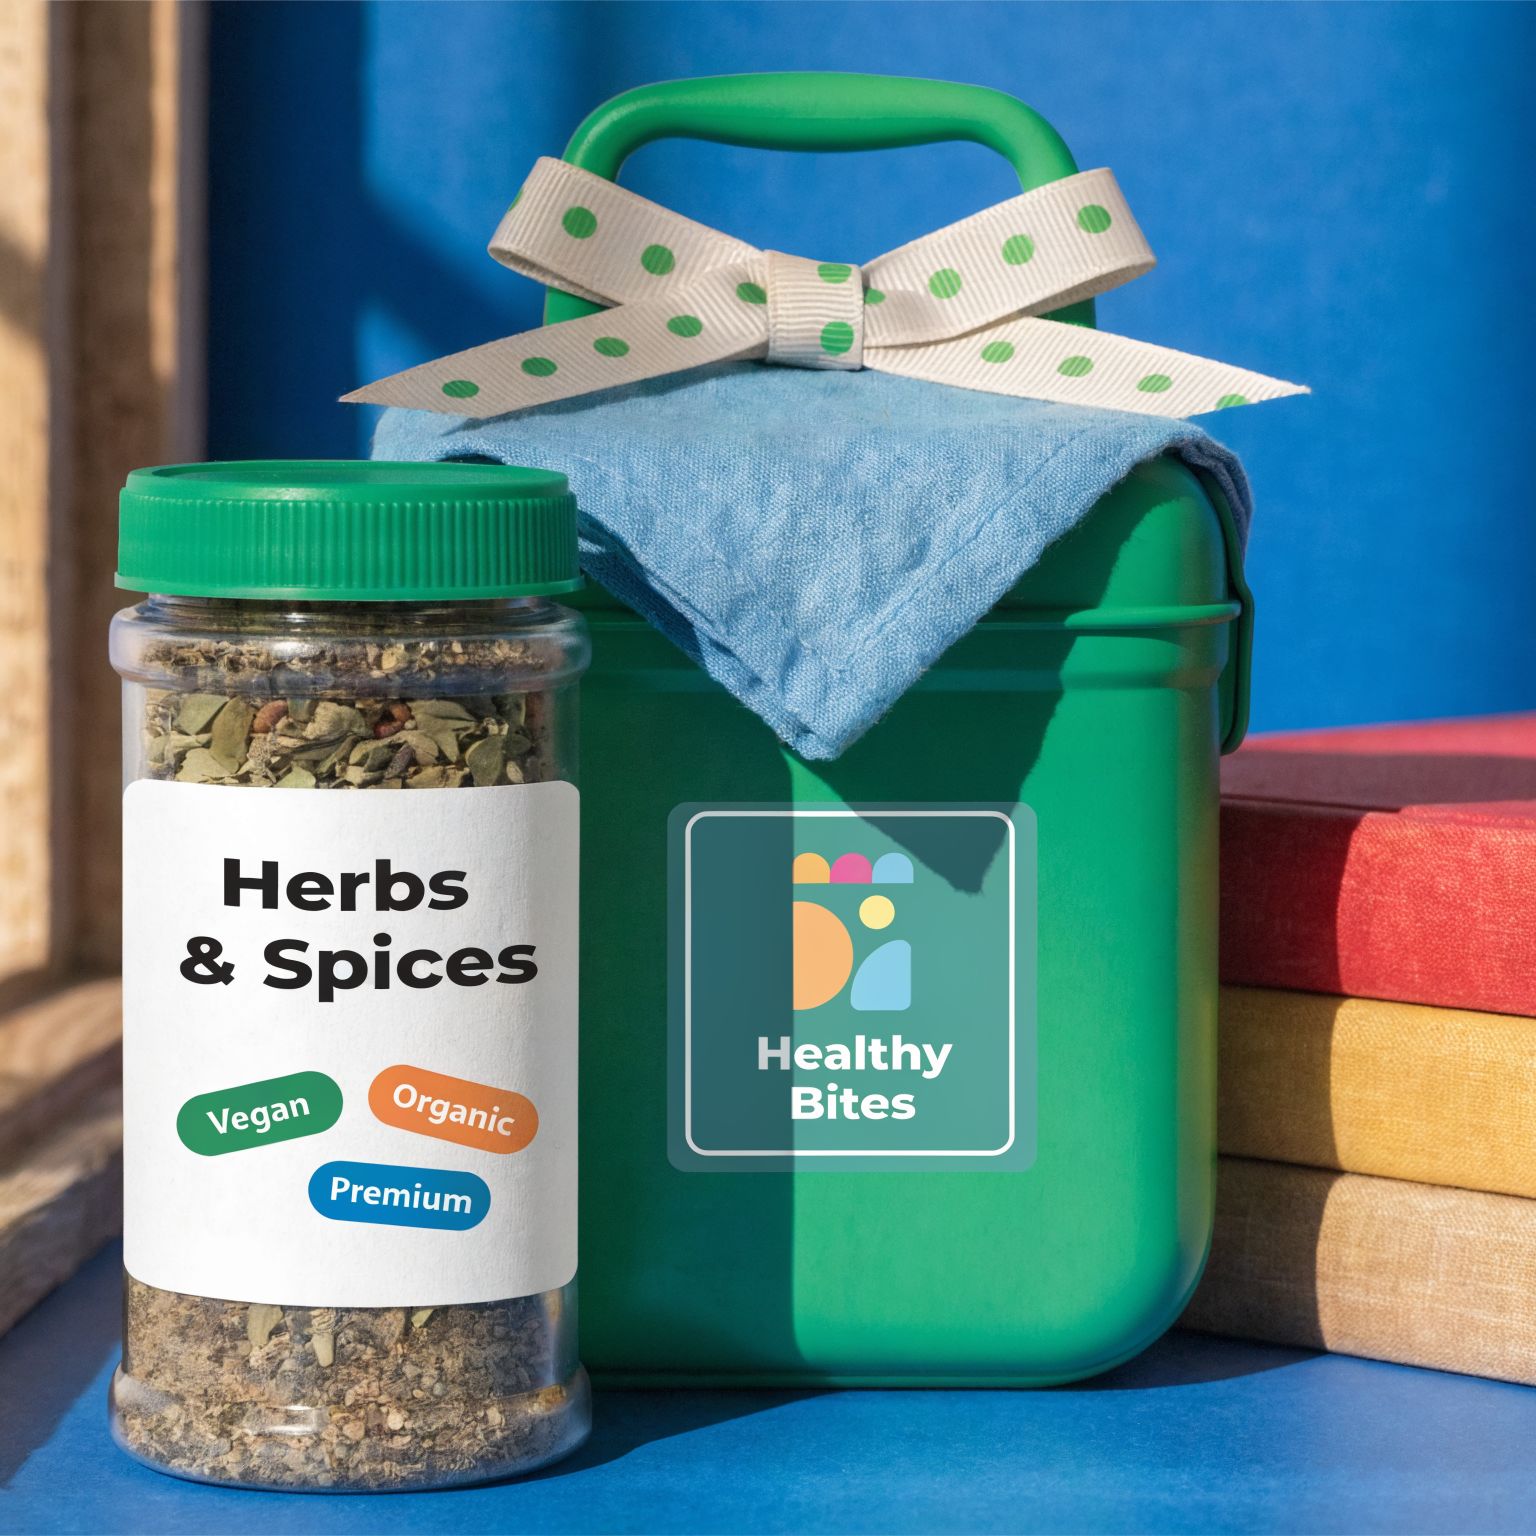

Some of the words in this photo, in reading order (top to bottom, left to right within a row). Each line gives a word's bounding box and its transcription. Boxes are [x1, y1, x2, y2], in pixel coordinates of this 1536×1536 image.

[223, 857, 469, 912] Herbs
[179, 936, 235, 986] &
[263, 932, 539, 1003] Spices
[757, 1034, 953, 1079] Healthy
[206, 1097, 310, 1135] Vegan
[392, 1083, 515, 1137] Organic
[791, 1082, 916, 1120] Bites
[330, 1176, 472, 1214] Premium
